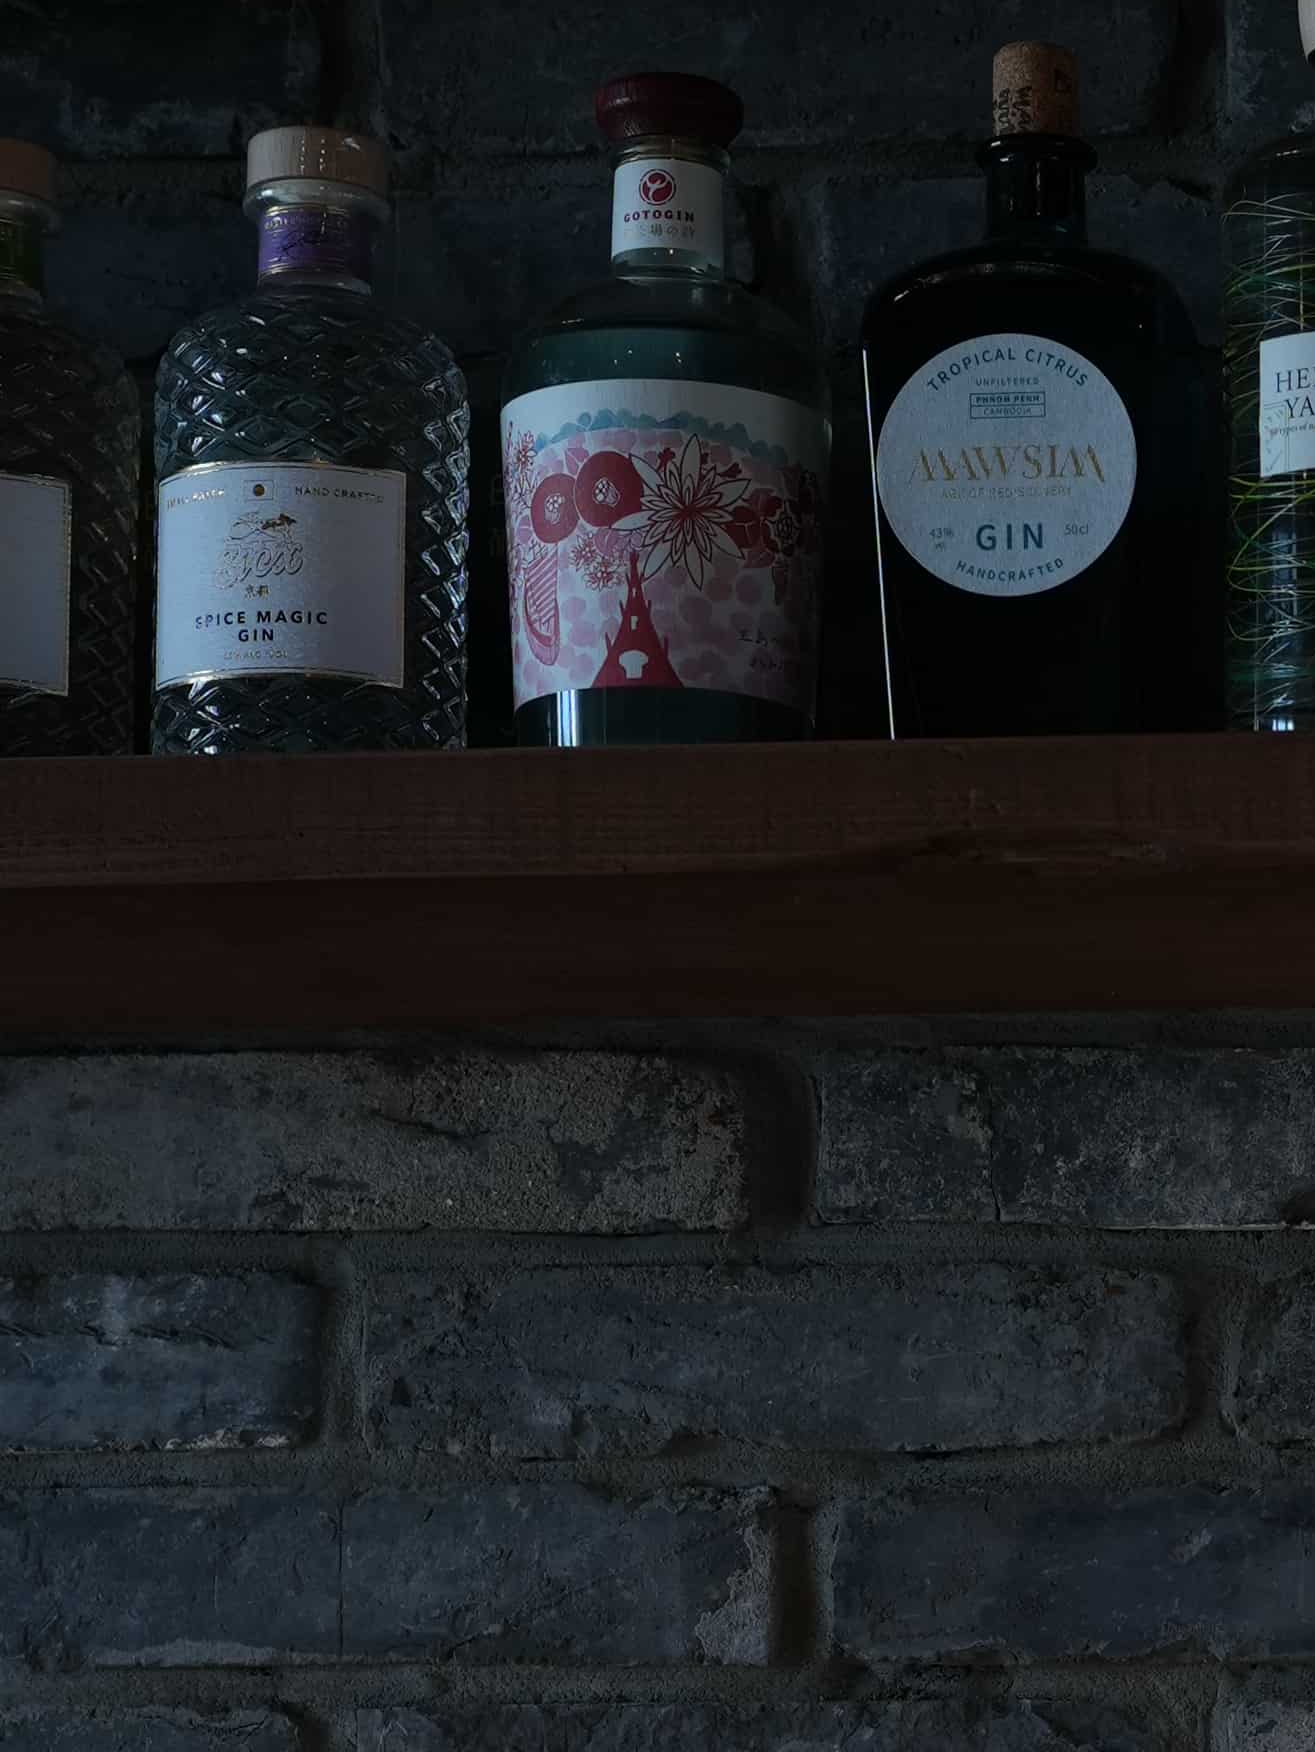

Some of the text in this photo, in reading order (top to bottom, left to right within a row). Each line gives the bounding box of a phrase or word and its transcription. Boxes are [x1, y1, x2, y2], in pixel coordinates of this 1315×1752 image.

[623, 209, 694, 223] GOTOGIN
[926, 347, 1089, 393] TROPICAL CITRUS
[295, 485, 330, 497] HAND
[976, 523, 1043, 551] GIN
[1064, 522, 1089, 537] 50cl
[955, 558, 1065, 583] HANDCRAFTED
[194, 610, 330, 630] SPICE MAGIC
[237, 628, 275, 643] GIN
